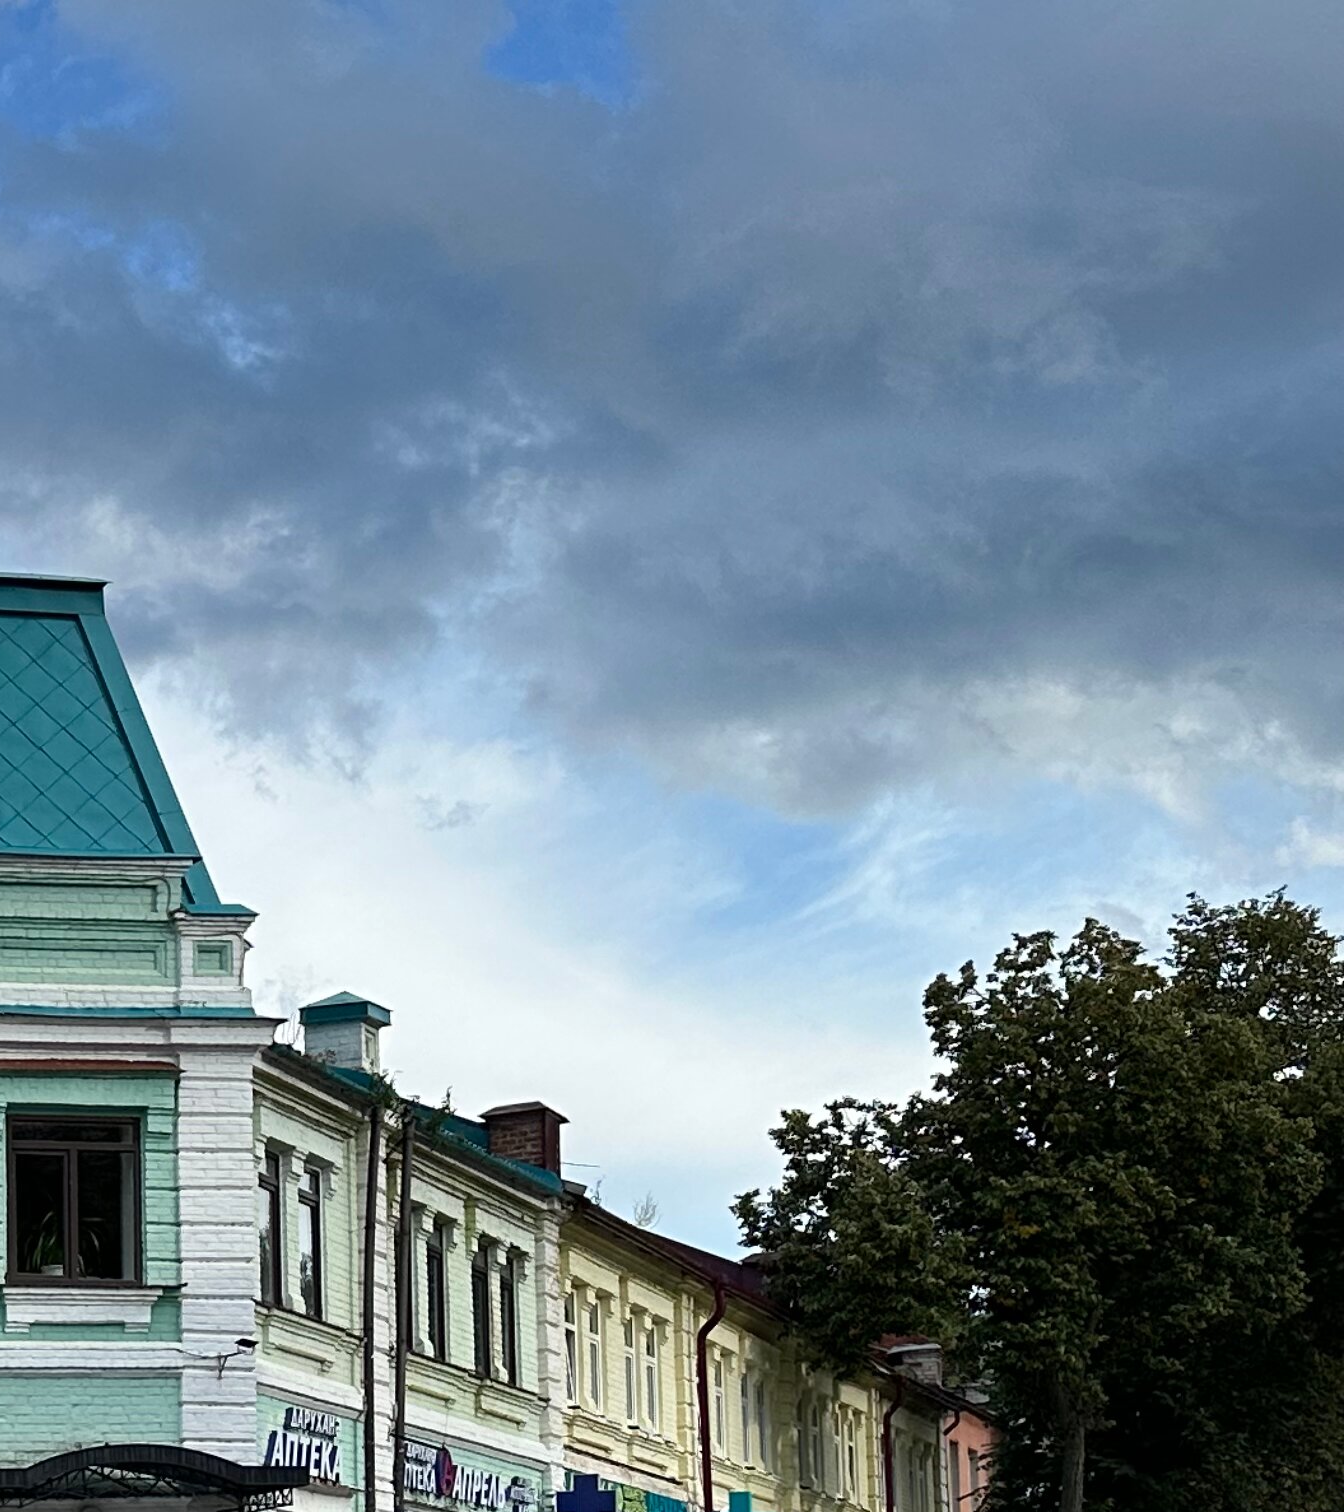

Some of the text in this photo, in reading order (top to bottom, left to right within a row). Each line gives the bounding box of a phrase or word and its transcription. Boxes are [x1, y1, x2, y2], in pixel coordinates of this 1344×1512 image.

[270, 1428, 342, 1482] АПТЕКА
[403, 1462, 437, 1494] ПТЕКА
[452, 1466, 507, 1509] АПРЕЛЬ
